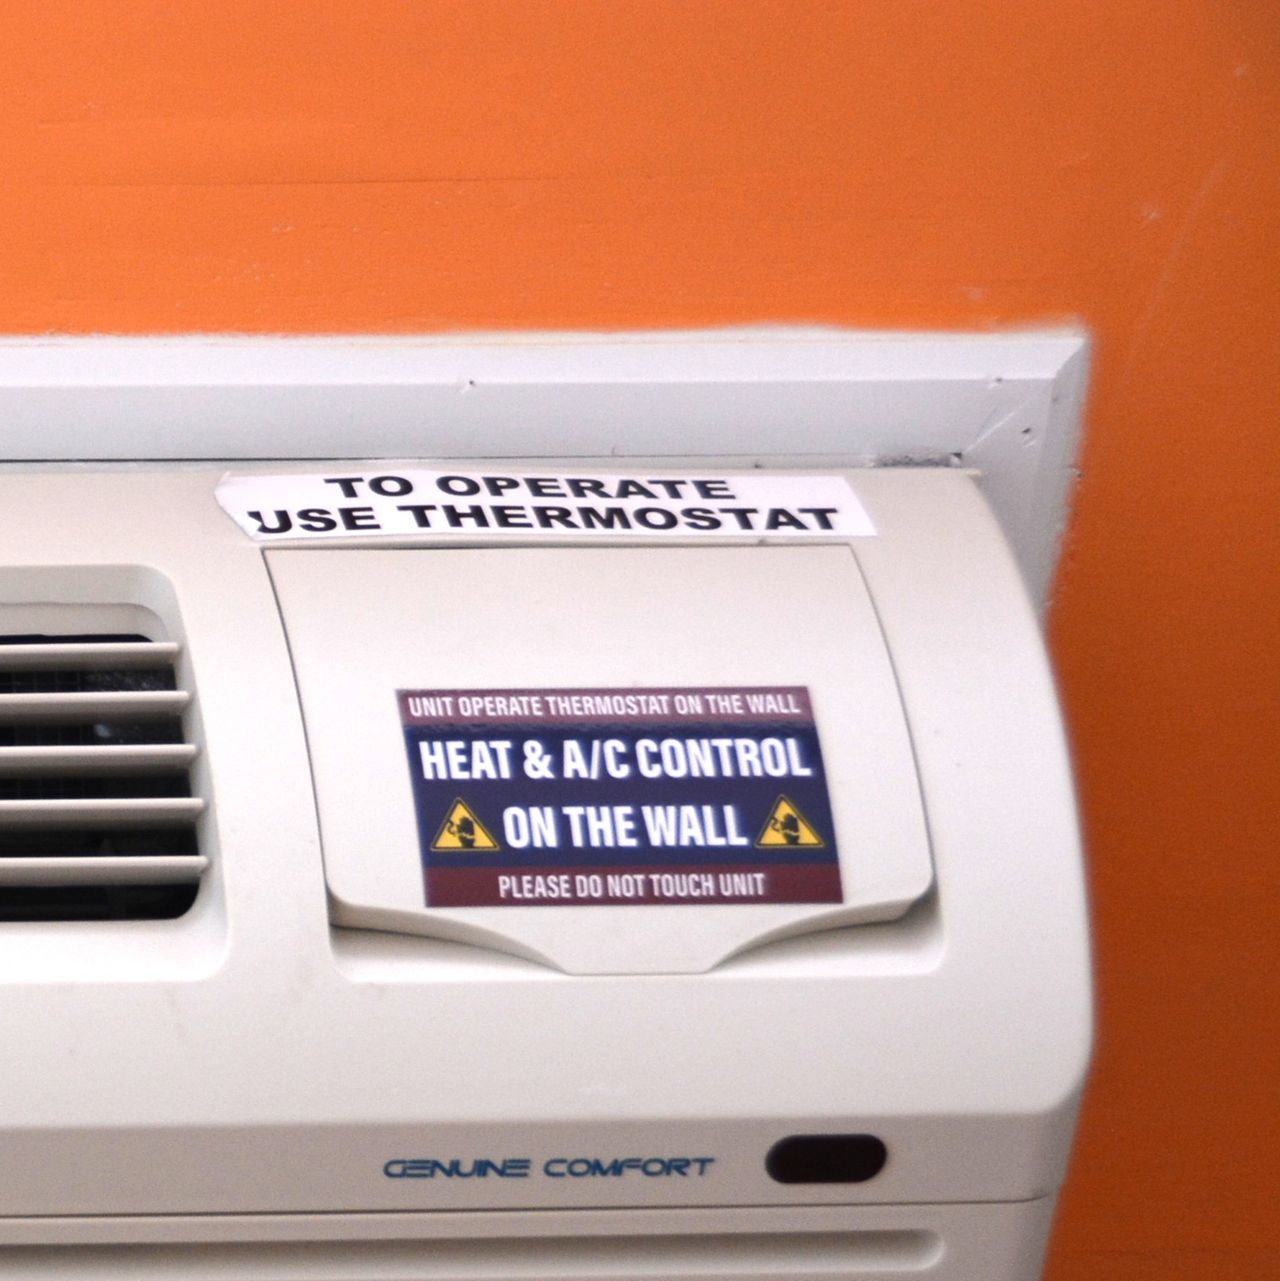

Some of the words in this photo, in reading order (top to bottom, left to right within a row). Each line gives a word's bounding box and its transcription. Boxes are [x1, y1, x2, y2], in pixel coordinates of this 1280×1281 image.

[324, 475, 413, 498] TO
[435, 475, 736, 499] OPERATE
[248, 506, 381, 534] USE
[397, 504, 840, 532] THERMOSTAT
[408, 697, 453, 717] UNIT
[458, 696, 541, 717] OPERATE
[544, 695, 671, 715] THERMOSTAT
[675, 694, 704, 714] ON
[707, 694, 743, 714] THE
[747, 694, 801, 714] WALL
[419, 740, 513, 780] HEAT
[522, 740, 555, 779] &
[562, 739, 630, 780] A/C
[635, 737, 813, 778] CONTROL
[502, 806, 558, 848] ON
[562, 805, 638, 848] THE
[641, 804, 748, 847] WALL
[498, 874, 572, 898] PLEASE
[575, 874, 604, 897] DO
[607, 874, 646, 897] NOT
[648, 873, 714, 897] TOUCH
[719, 872, 766, 896] UNIT
[383, 1159, 532, 1178] GENUINE
[543, 1157, 715, 1177] COMFORT
